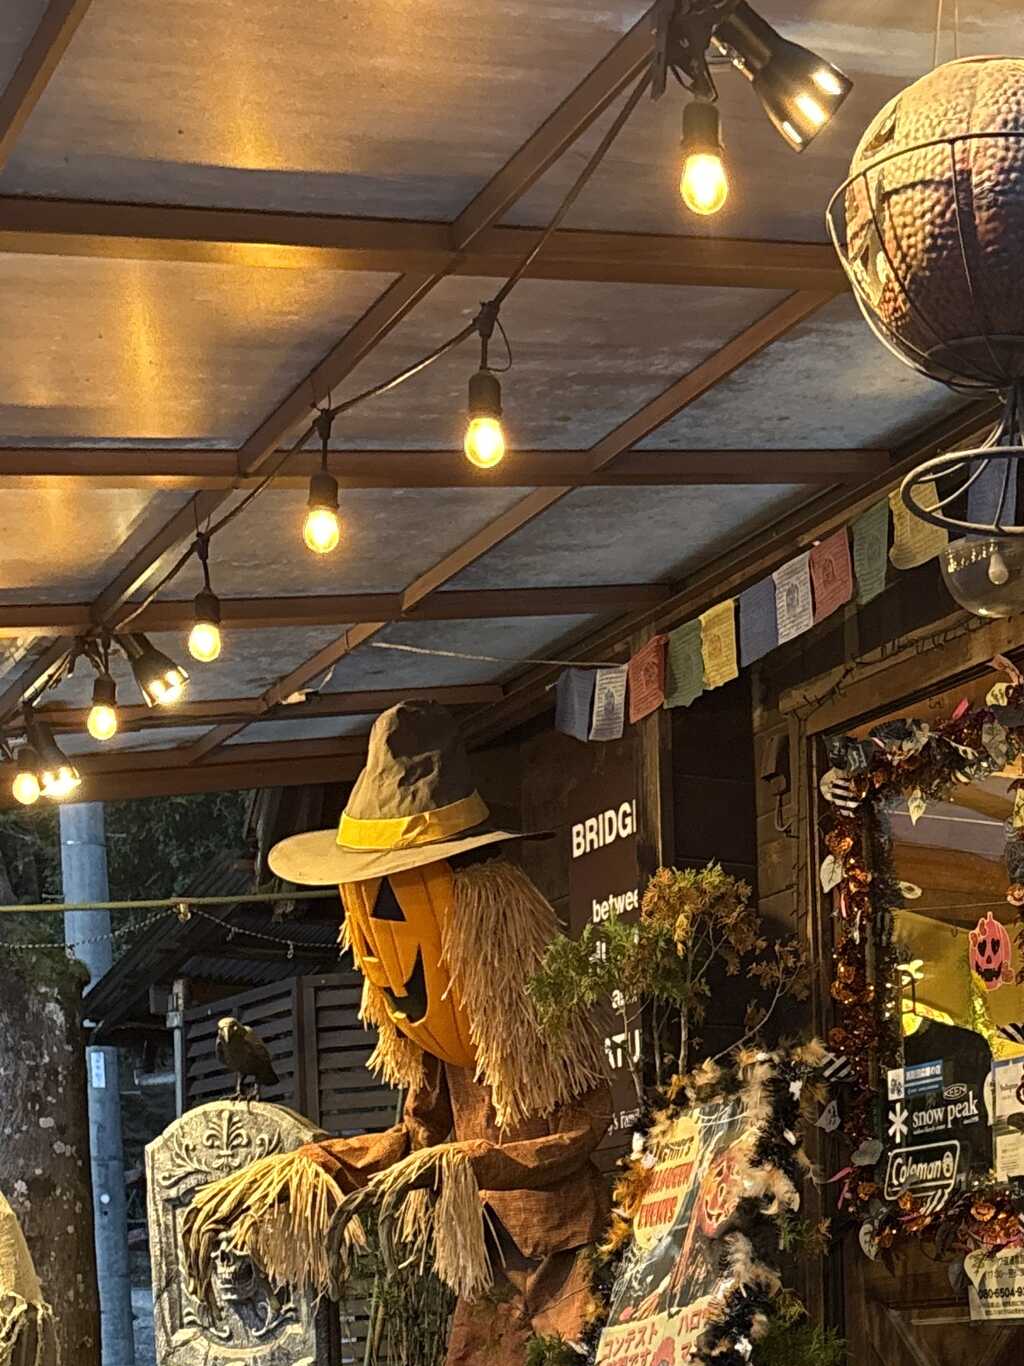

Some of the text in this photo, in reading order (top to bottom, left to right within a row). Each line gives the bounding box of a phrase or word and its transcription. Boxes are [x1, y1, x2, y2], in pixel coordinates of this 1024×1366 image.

[912, 1106, 946, 1129] snow
[947, 1090, 979, 1129] peak
[892, 1156, 941, 1186] Coleman
[677, 1306, 706, 1337] ハロ
[602, 1321, 658, 1362] コンテスト
